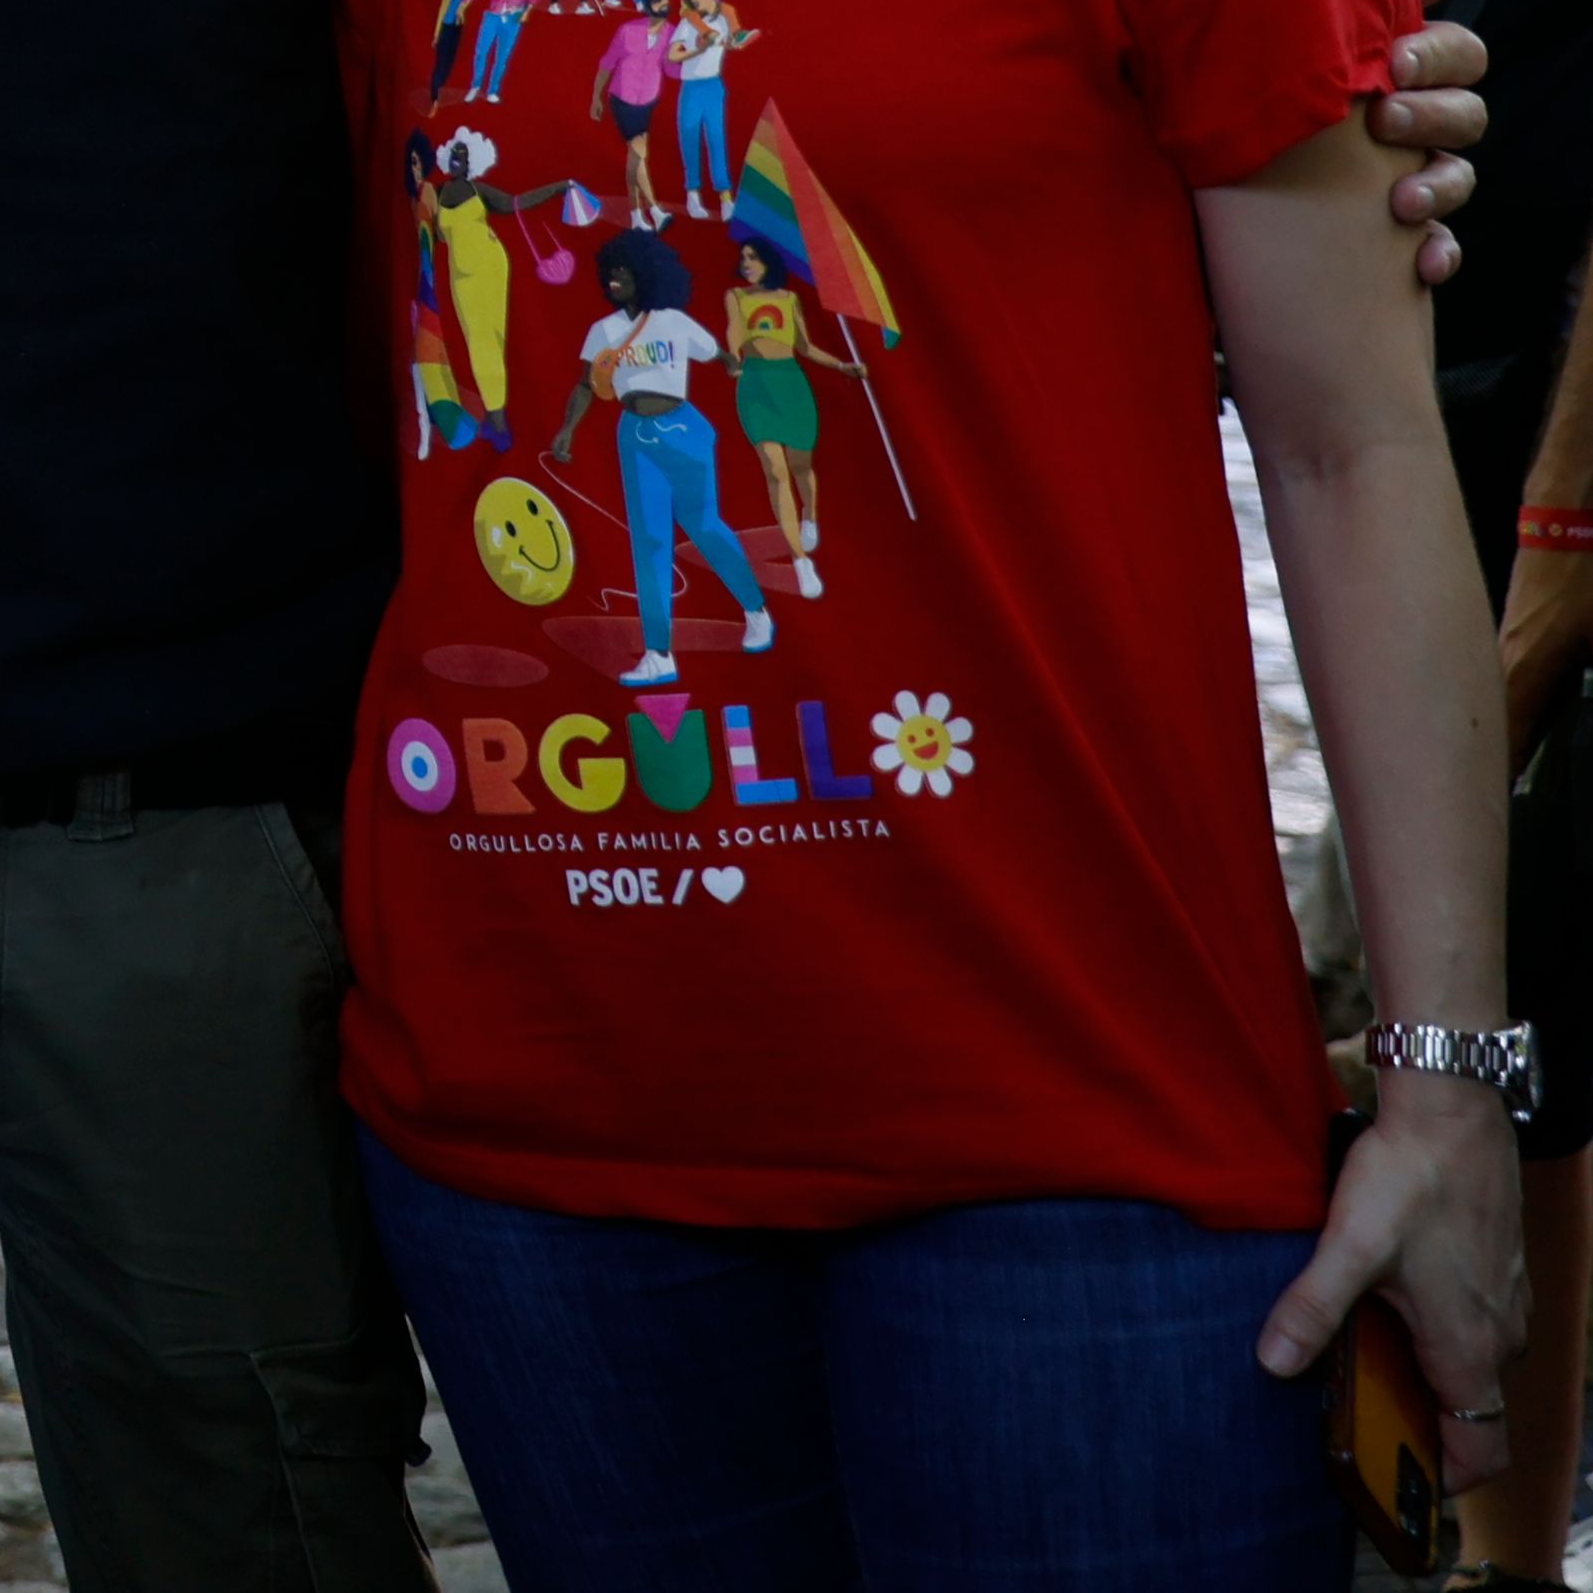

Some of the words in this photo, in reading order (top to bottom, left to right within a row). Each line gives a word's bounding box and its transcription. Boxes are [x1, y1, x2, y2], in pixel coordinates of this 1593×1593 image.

[449, 832, 584, 853] ORGULLOSA
[597, 832, 702, 851] FAMILIA
[717, 818, 891, 849] SOCIALISTA
